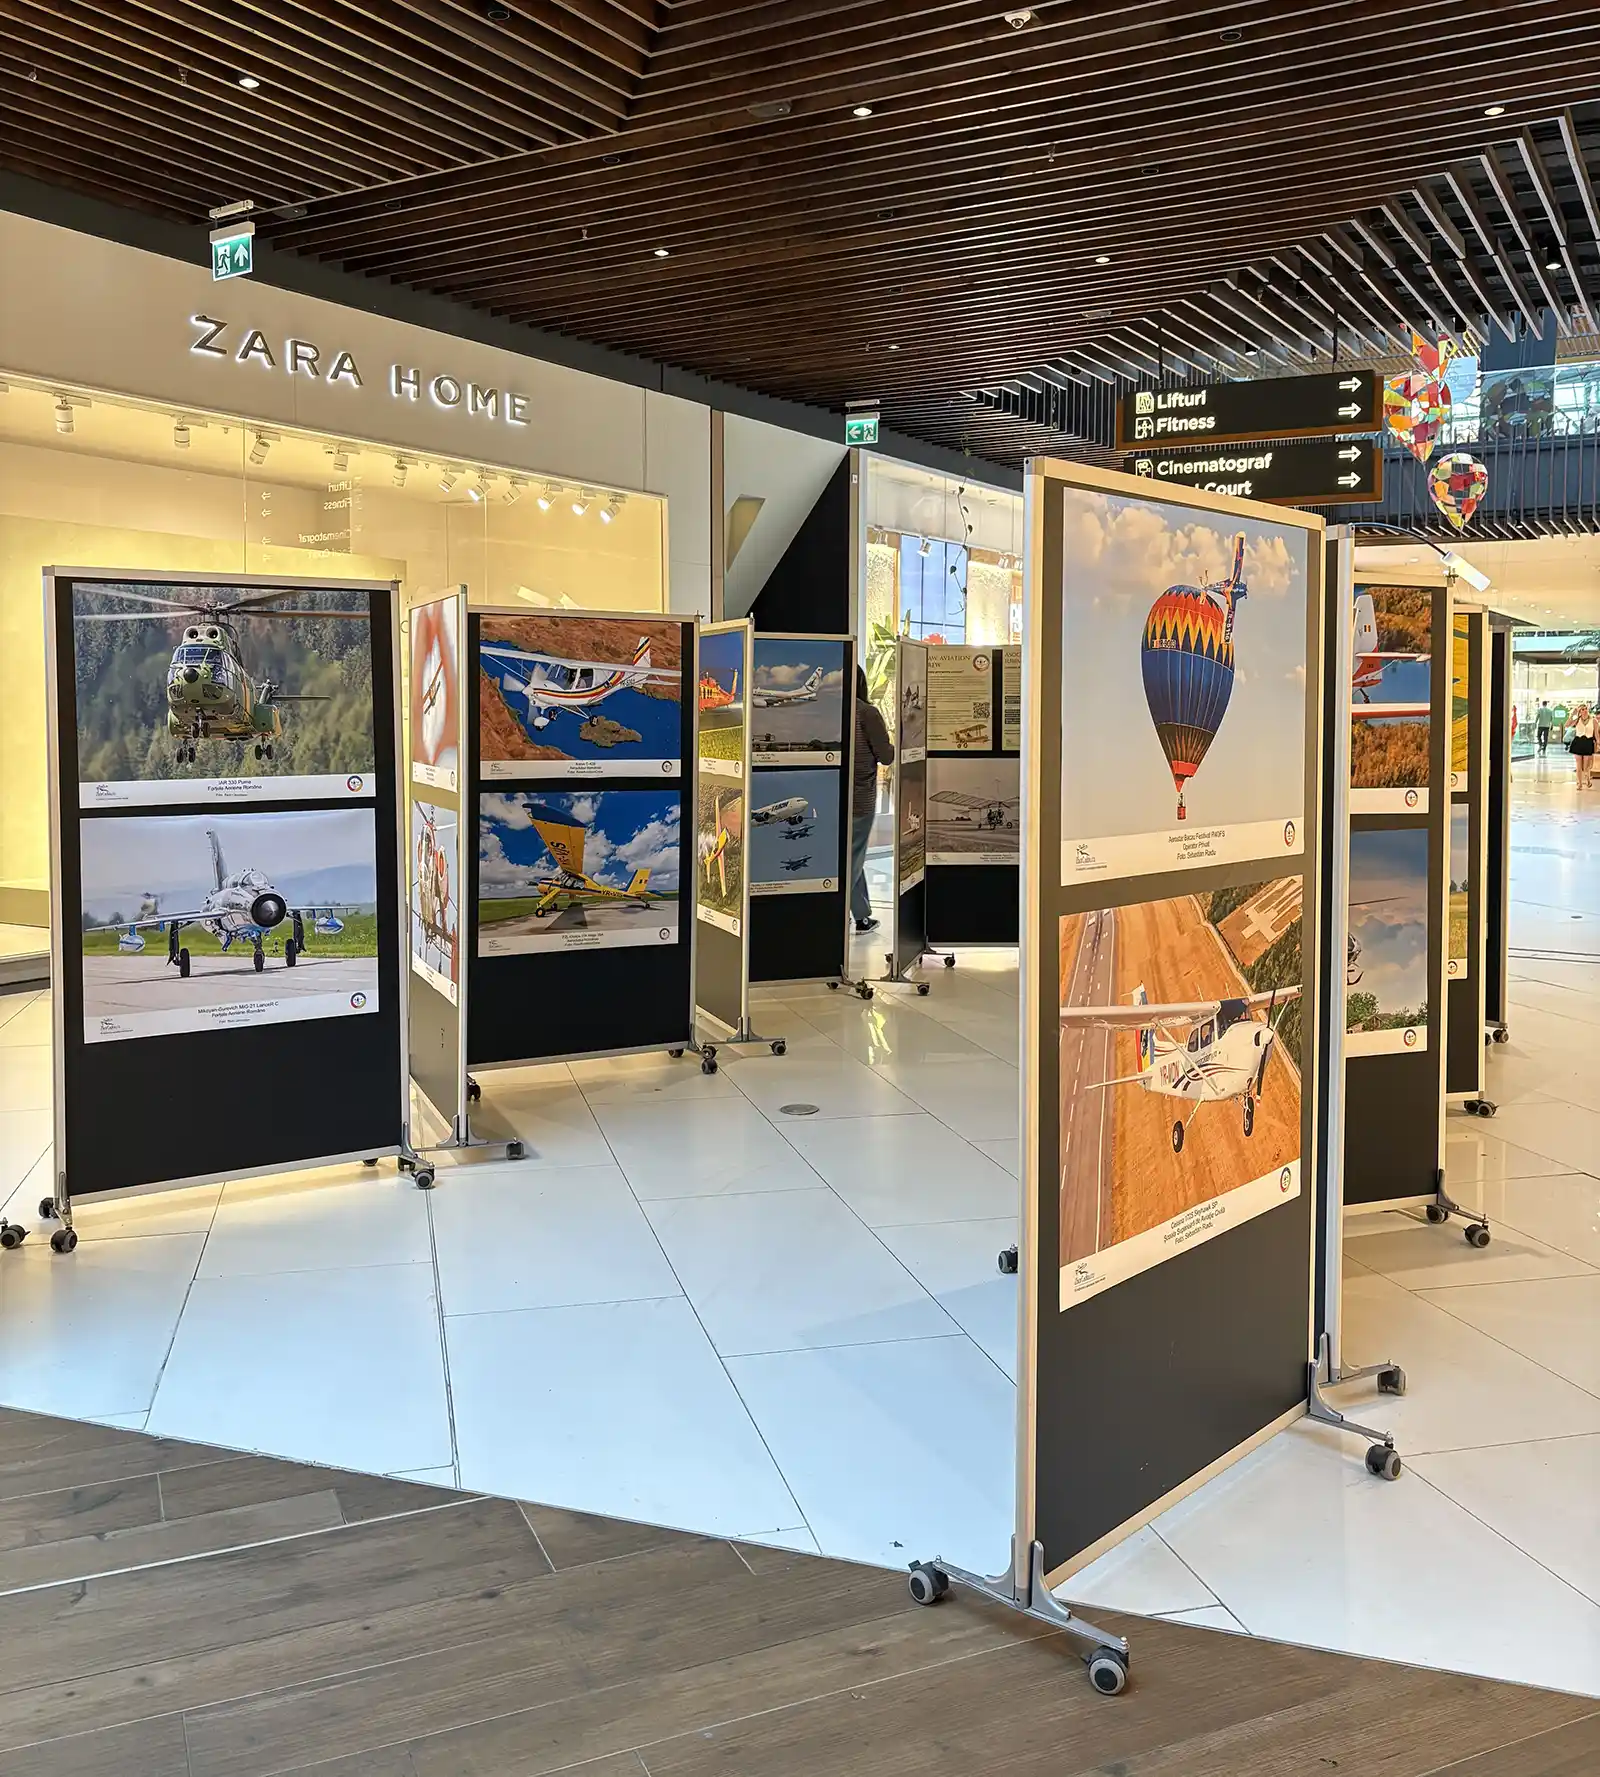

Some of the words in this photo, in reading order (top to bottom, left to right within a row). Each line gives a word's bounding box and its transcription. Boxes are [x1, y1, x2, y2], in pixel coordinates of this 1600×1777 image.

[189, 313, 364, 388] ZARA
[389, 364, 532, 425] HOME
[1156, 389, 1207, 409] Lifturi
[1156, 415, 1216, 433] Fitness
[1156, 453, 1273, 476] Cinematograf
[1203, 480, 1253, 496] Court
